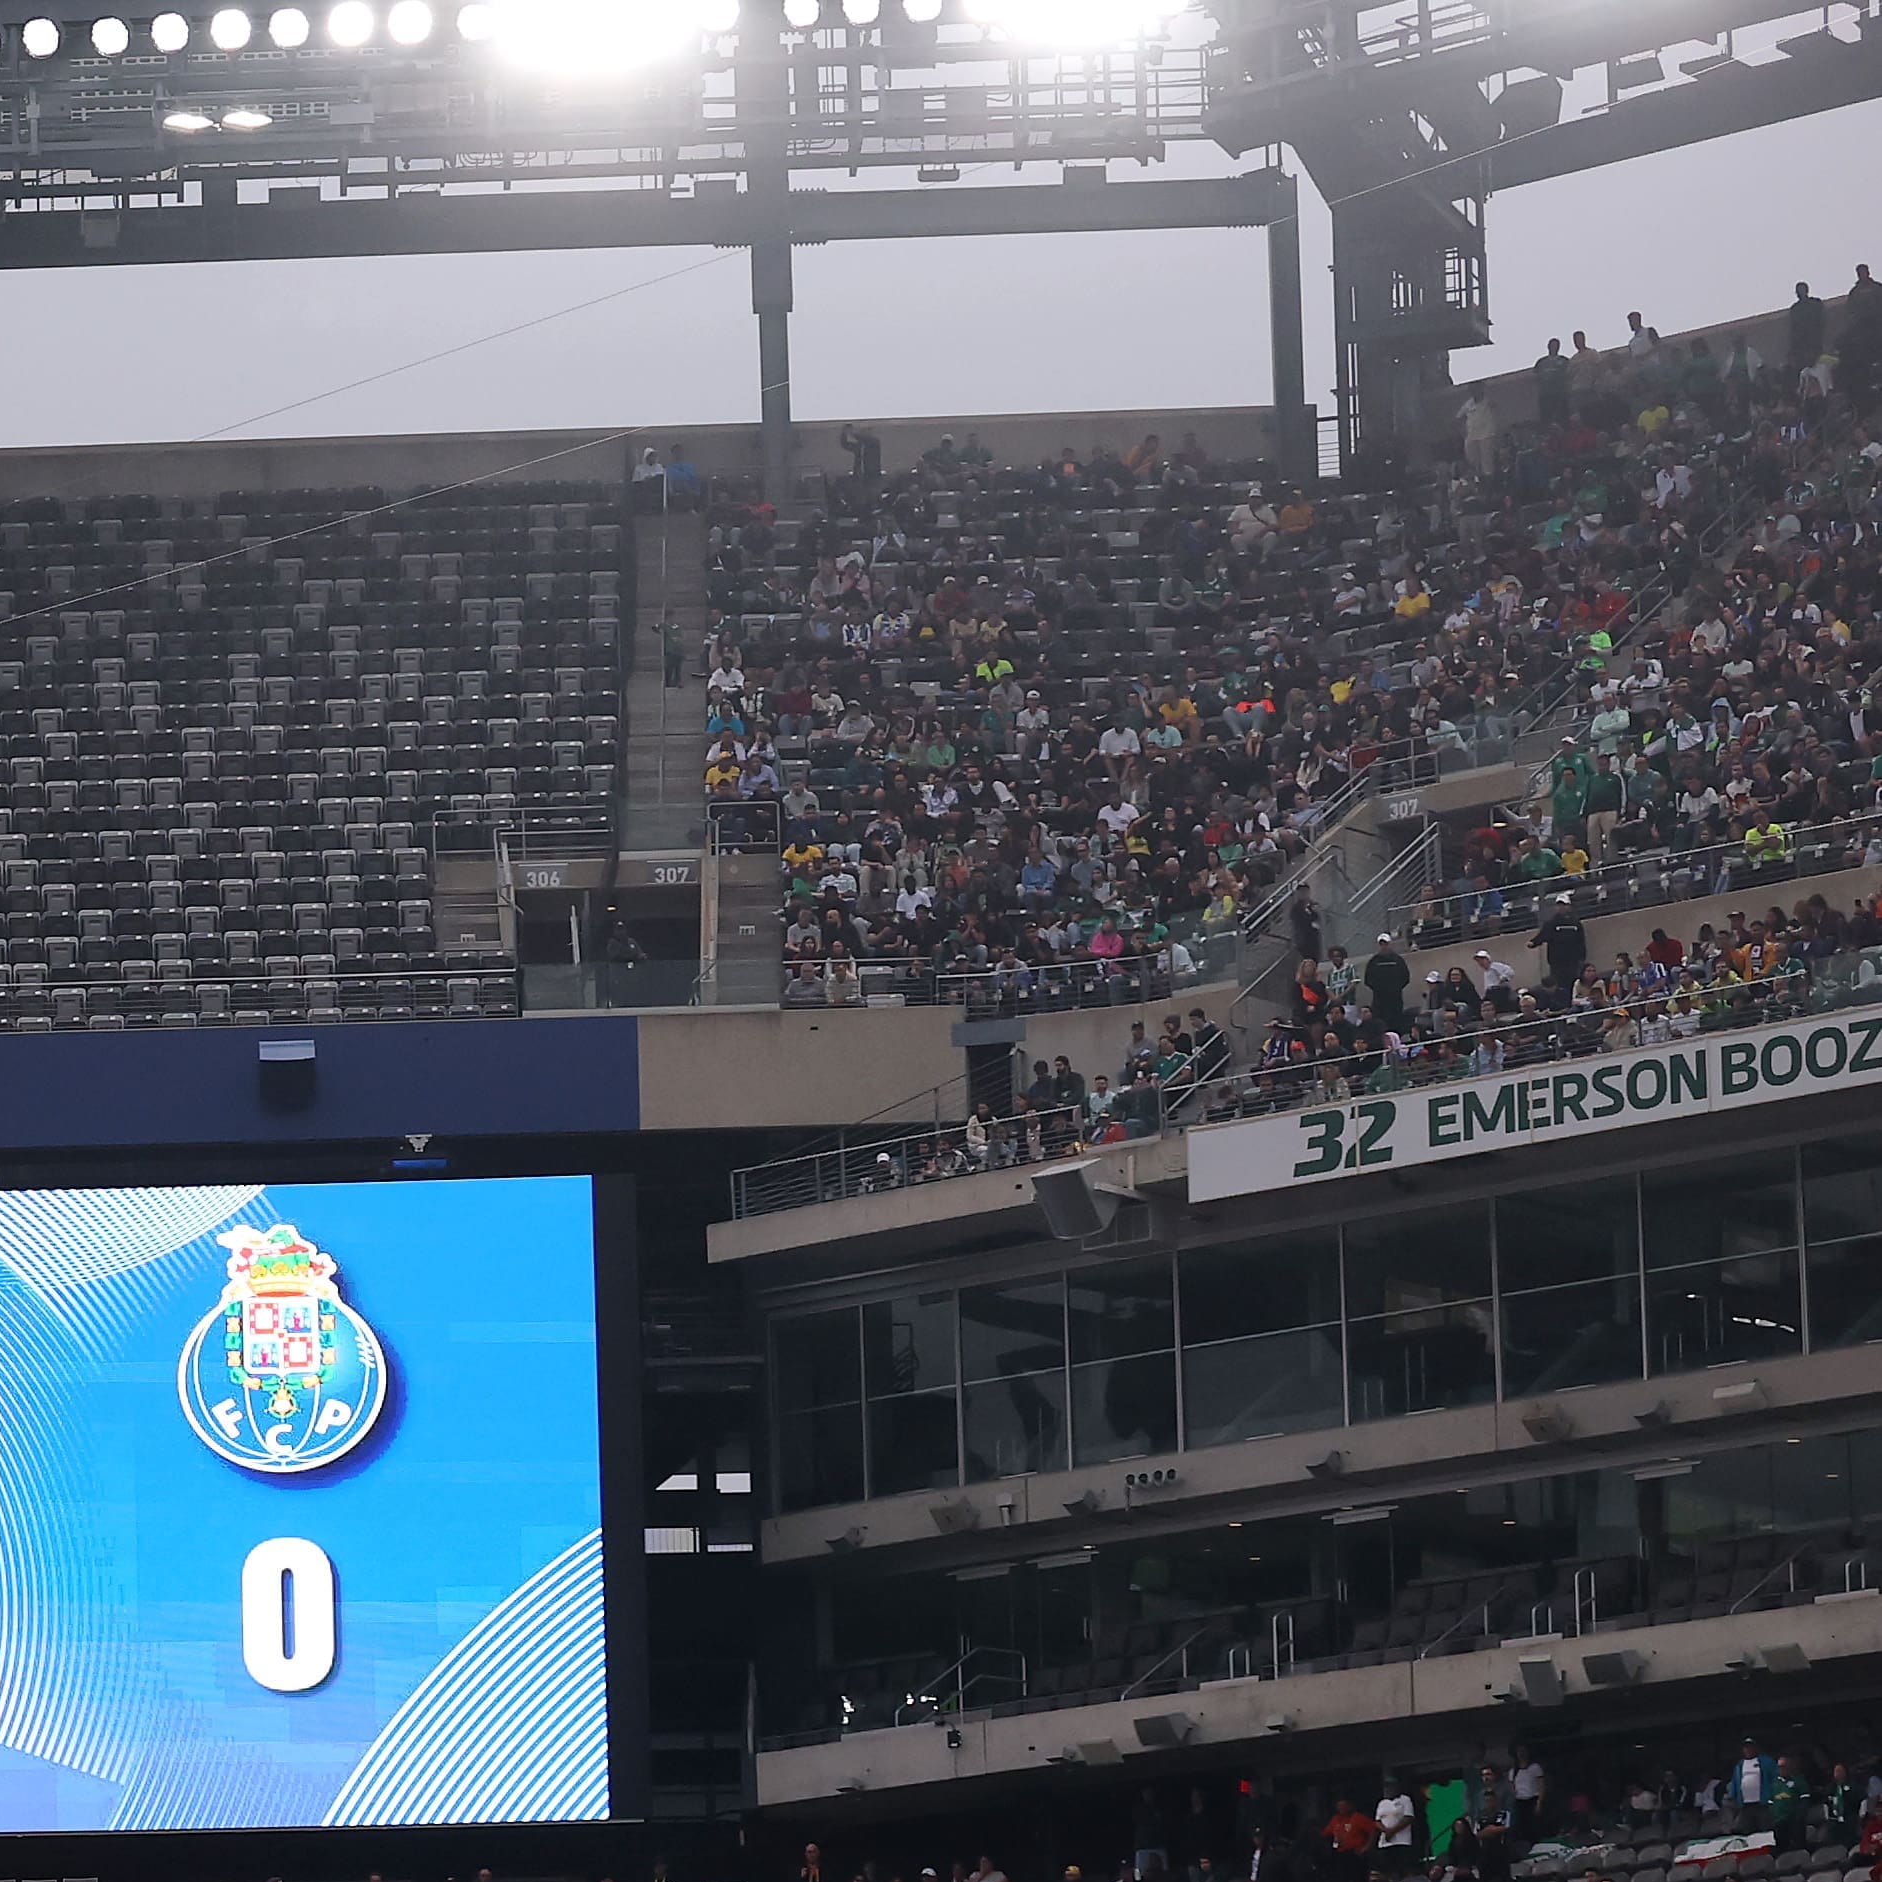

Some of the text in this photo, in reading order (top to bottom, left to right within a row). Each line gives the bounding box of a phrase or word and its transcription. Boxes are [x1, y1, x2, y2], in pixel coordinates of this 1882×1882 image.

[1388, 798, 1419, 819] 307
[526, 870, 561, 887] 306
[654, 867, 689, 884] 307
[1292, 1018, 1882, 1178] 32 EMERSON BOOZ
[241, 1536, 336, 1692] 0
